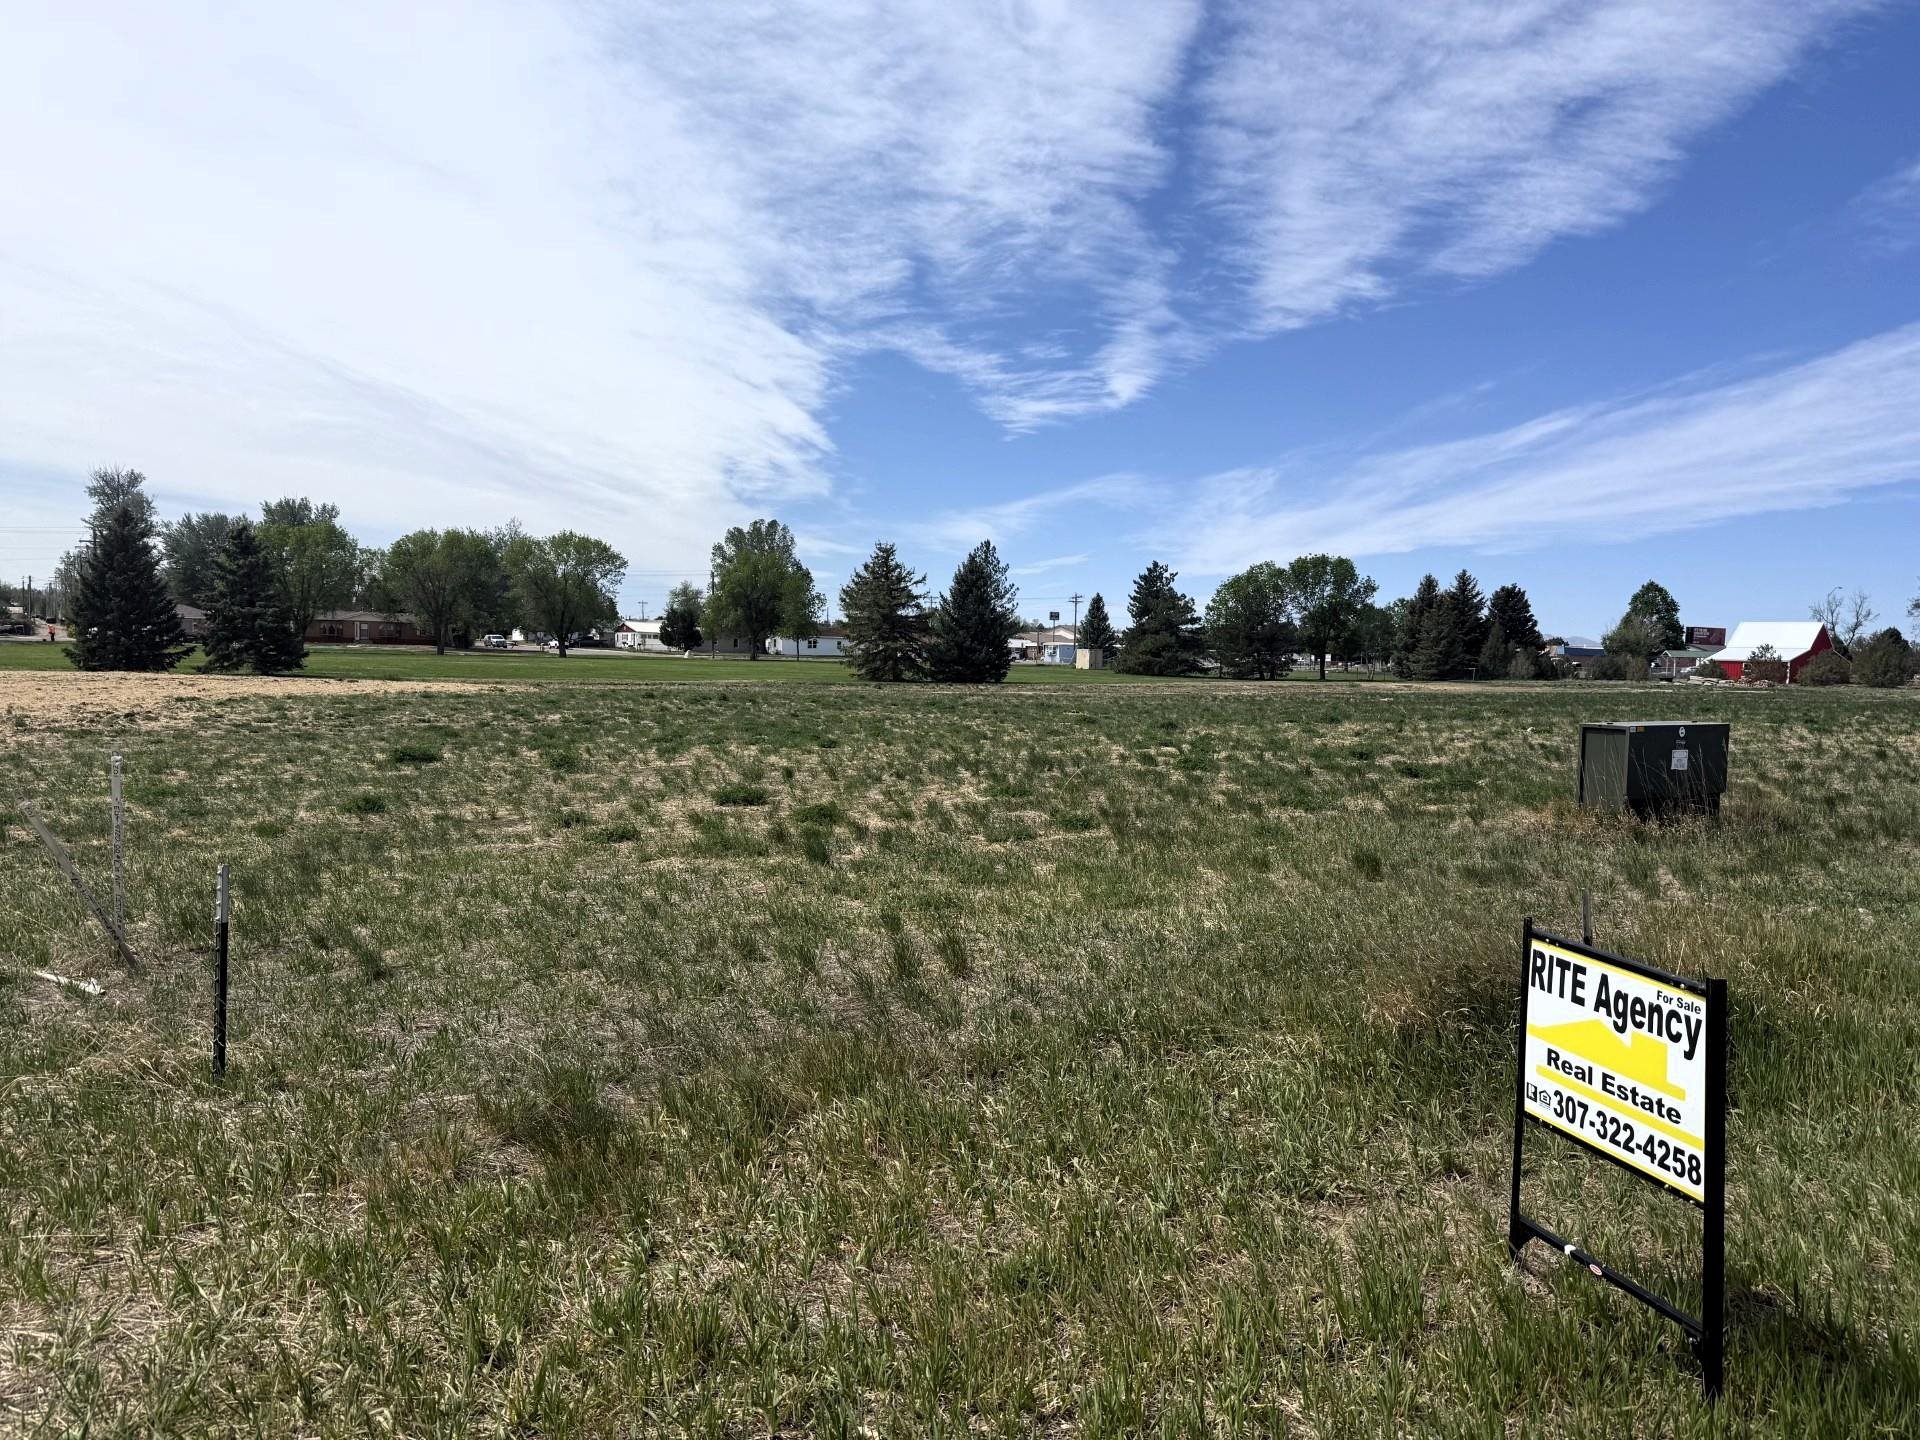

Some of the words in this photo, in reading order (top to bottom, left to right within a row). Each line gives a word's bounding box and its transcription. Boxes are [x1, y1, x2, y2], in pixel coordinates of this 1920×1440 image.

[1531, 949, 1587, 1007] RITE
[1594, 973, 1703, 1060] Agency
[1657, 990, 1674, 1004] For
[1677, 996, 1702, 1015] Sale
[1547, 1048, 1592, 1085] Real
[1602, 1072, 1682, 1125] Estate
[1554, 1090, 1702, 1186] 307-322-4258
